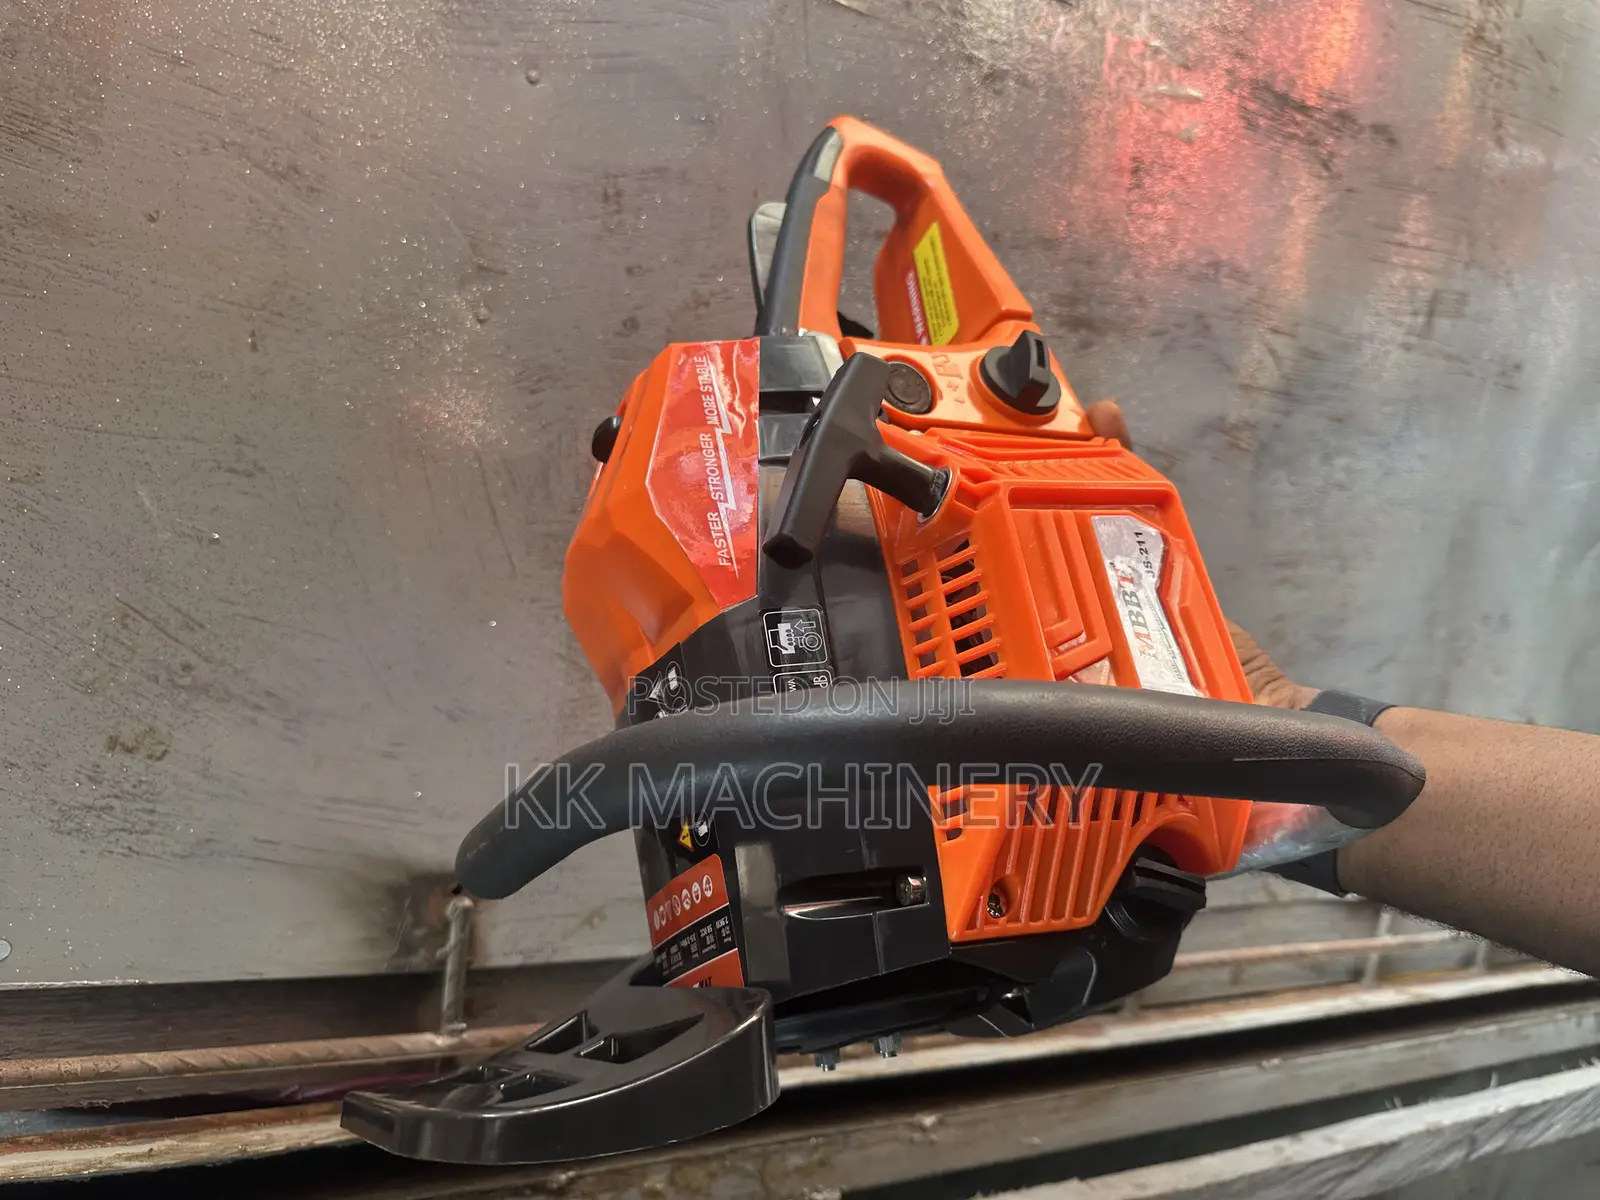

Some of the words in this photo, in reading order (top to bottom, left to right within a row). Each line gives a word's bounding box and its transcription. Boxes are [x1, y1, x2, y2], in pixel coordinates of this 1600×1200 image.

[694, 356, 713, 393] STABLE
[702, 395, 719, 426] MORE
[700, 433, 724, 501] STRONGER
[707, 511, 731, 566] FASTER
[1134, 532, 1155, 579] JS-211
[1115, 567, 1158, 661] MBBT
